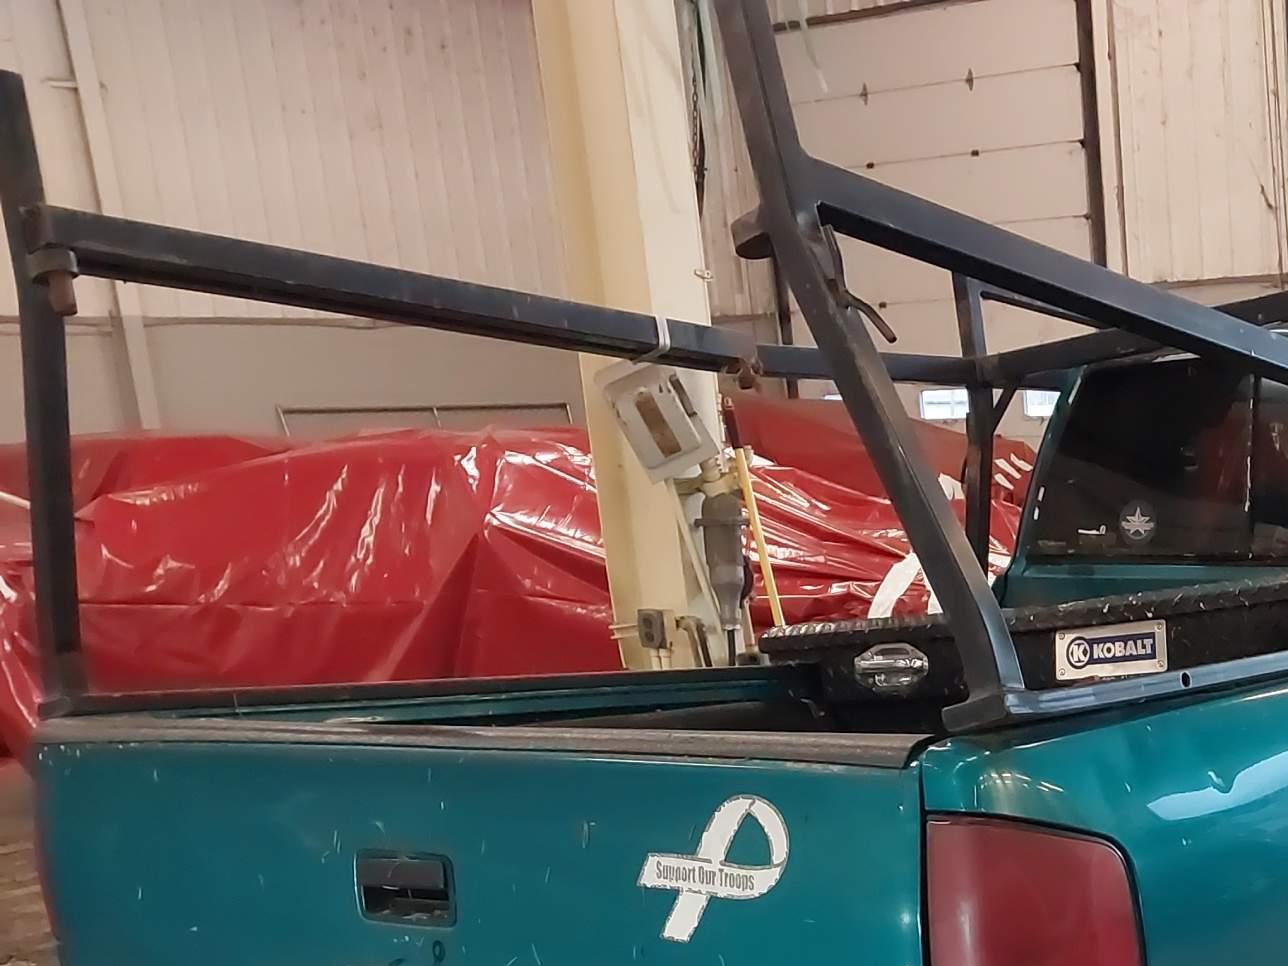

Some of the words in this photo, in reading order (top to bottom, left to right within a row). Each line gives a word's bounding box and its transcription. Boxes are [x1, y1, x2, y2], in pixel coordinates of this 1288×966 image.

[1092, 639, 1153, 659] KOBALT
[656, 860, 697, 884] Support
[698, 865, 717, 886] Our
[718, 868, 755, 892] Troops
